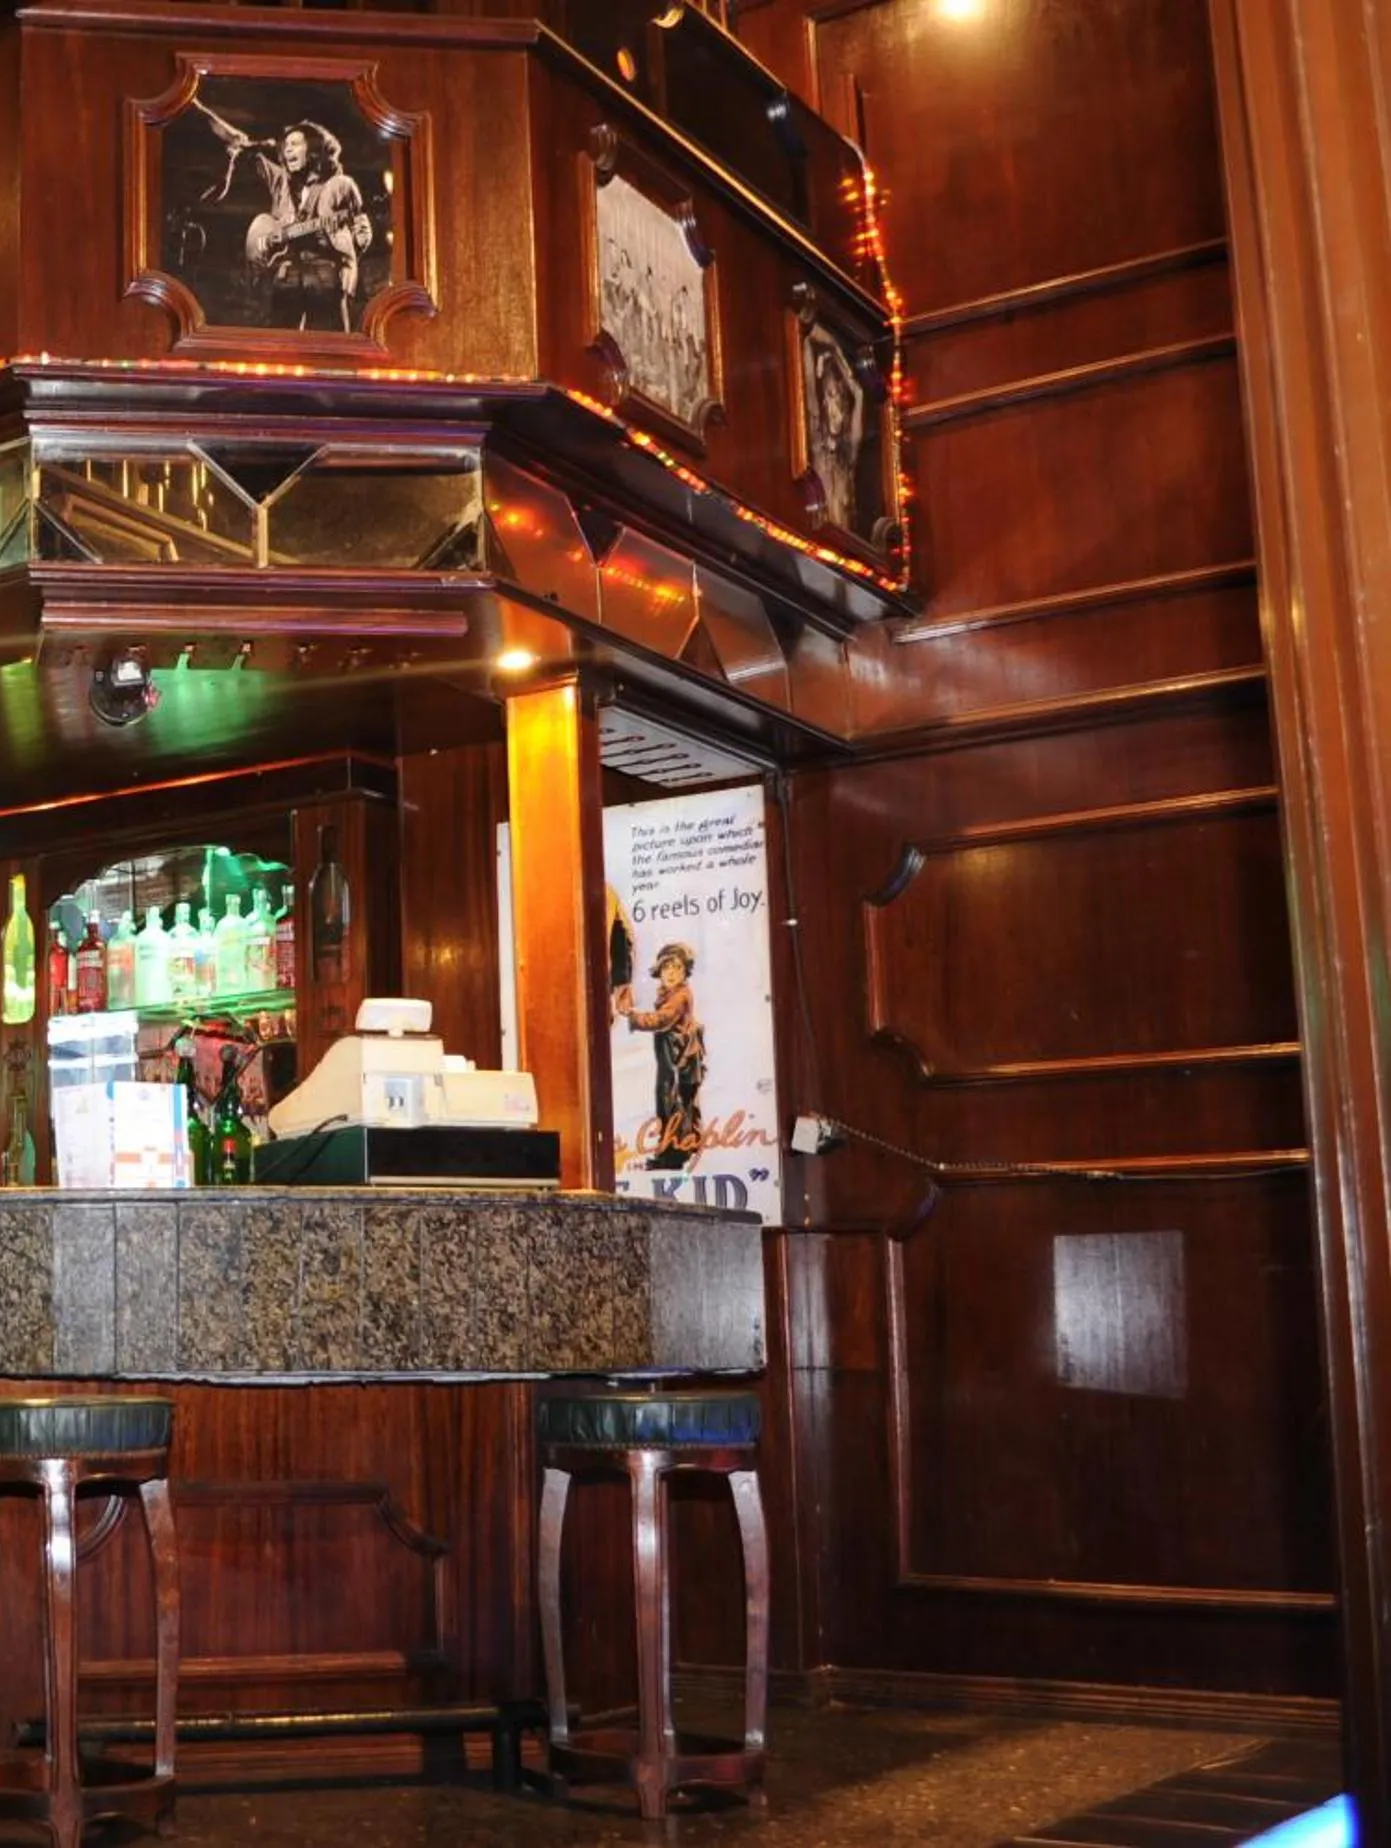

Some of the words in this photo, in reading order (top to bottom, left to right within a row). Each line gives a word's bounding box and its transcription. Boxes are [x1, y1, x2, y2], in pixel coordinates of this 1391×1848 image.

[631, 827, 655, 838] This
[675, 820, 695, 832] the
[698, 814, 736, 832] great
[631, 837, 676, 853] picture
[680, 833, 713, 847] upon
[717, 826, 754, 840] which
[631, 855, 653, 867] the
[656, 849, 703, 861] famous
[631, 868, 653, 879] has
[658, 860, 702, 875] worked
[706, 861, 715, 870] a
[718, 855, 757, 868] whole
[632, 899, 646, 923] 6
[651, 893, 701, 921] reels
[706, 888, 726, 913] of
[636, 1110, 776, 1173] Chaplin
